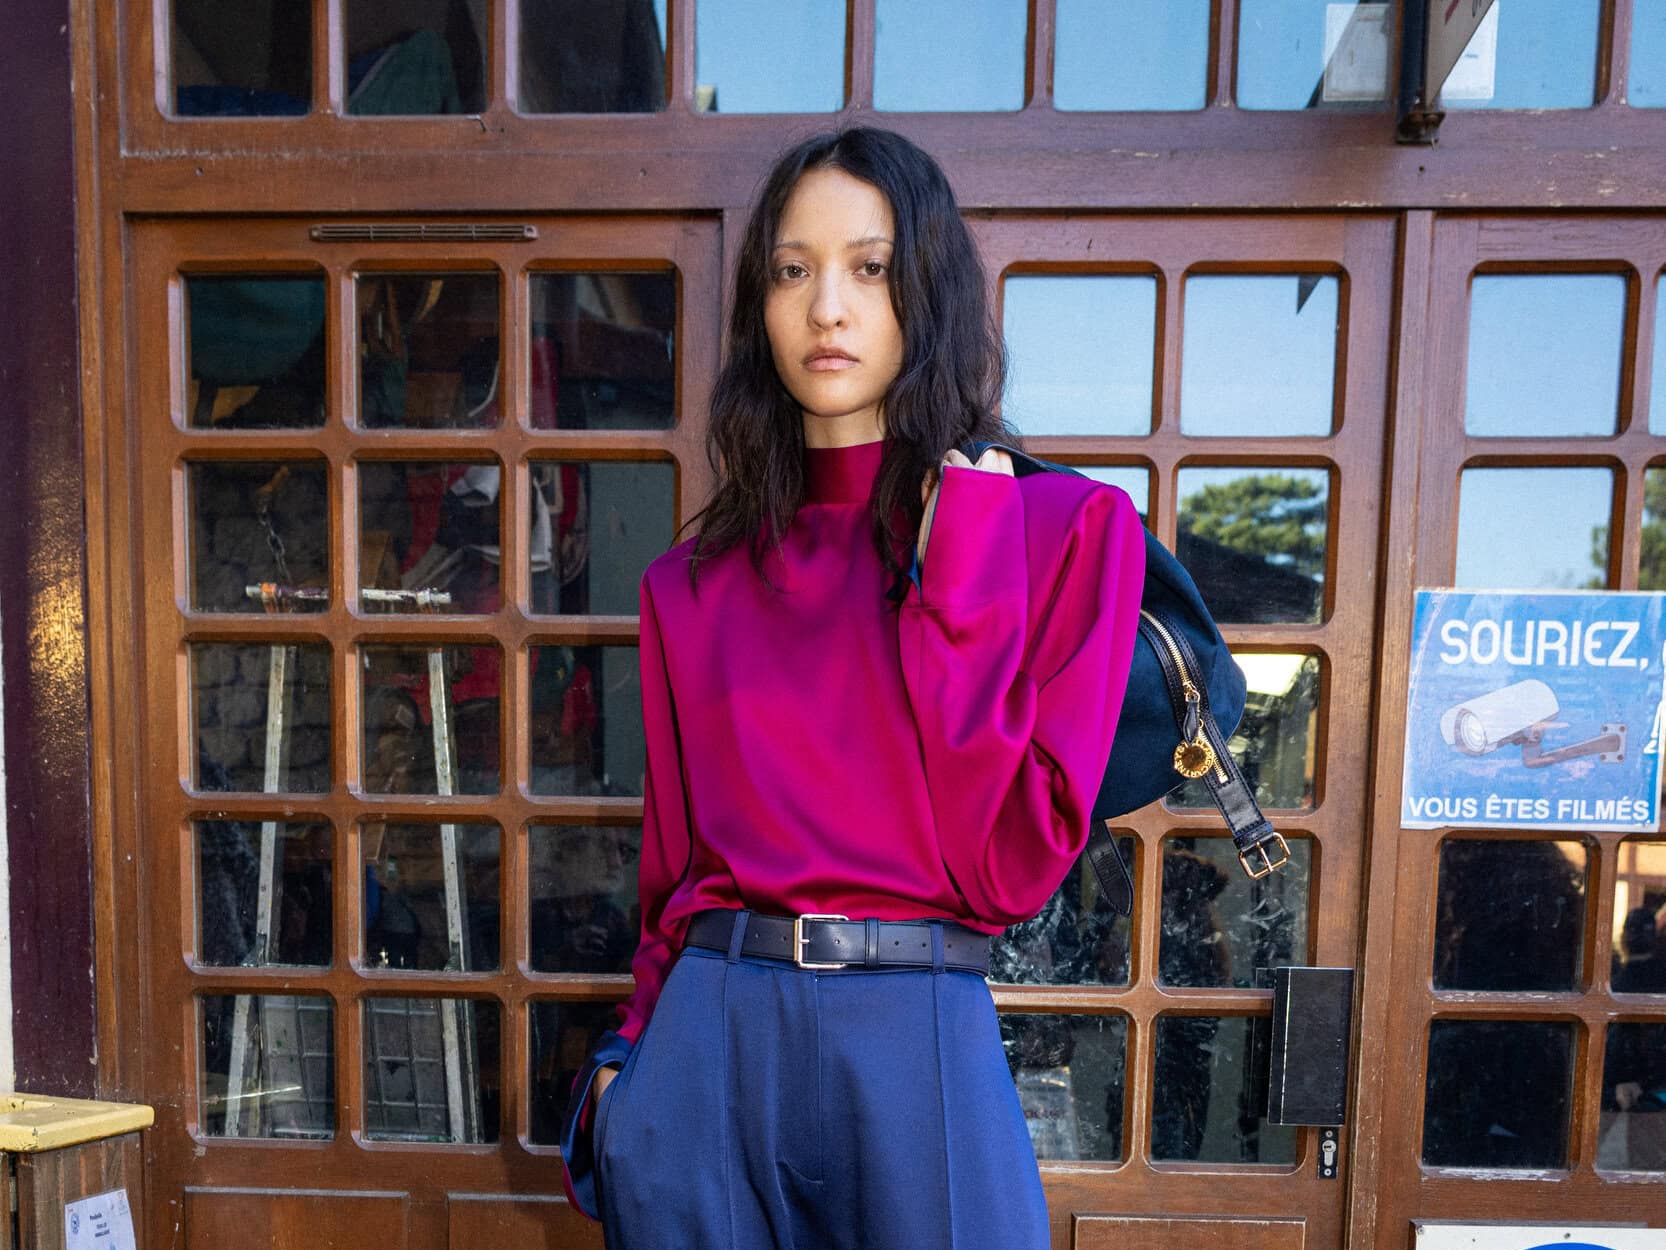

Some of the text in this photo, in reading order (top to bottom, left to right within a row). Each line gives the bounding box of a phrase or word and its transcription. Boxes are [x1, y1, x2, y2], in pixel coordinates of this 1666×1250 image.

[1439, 619, 1649, 670] SOURIEZ,
[1408, 794, 1649, 821] VOUS ÊTES FILMÉS
